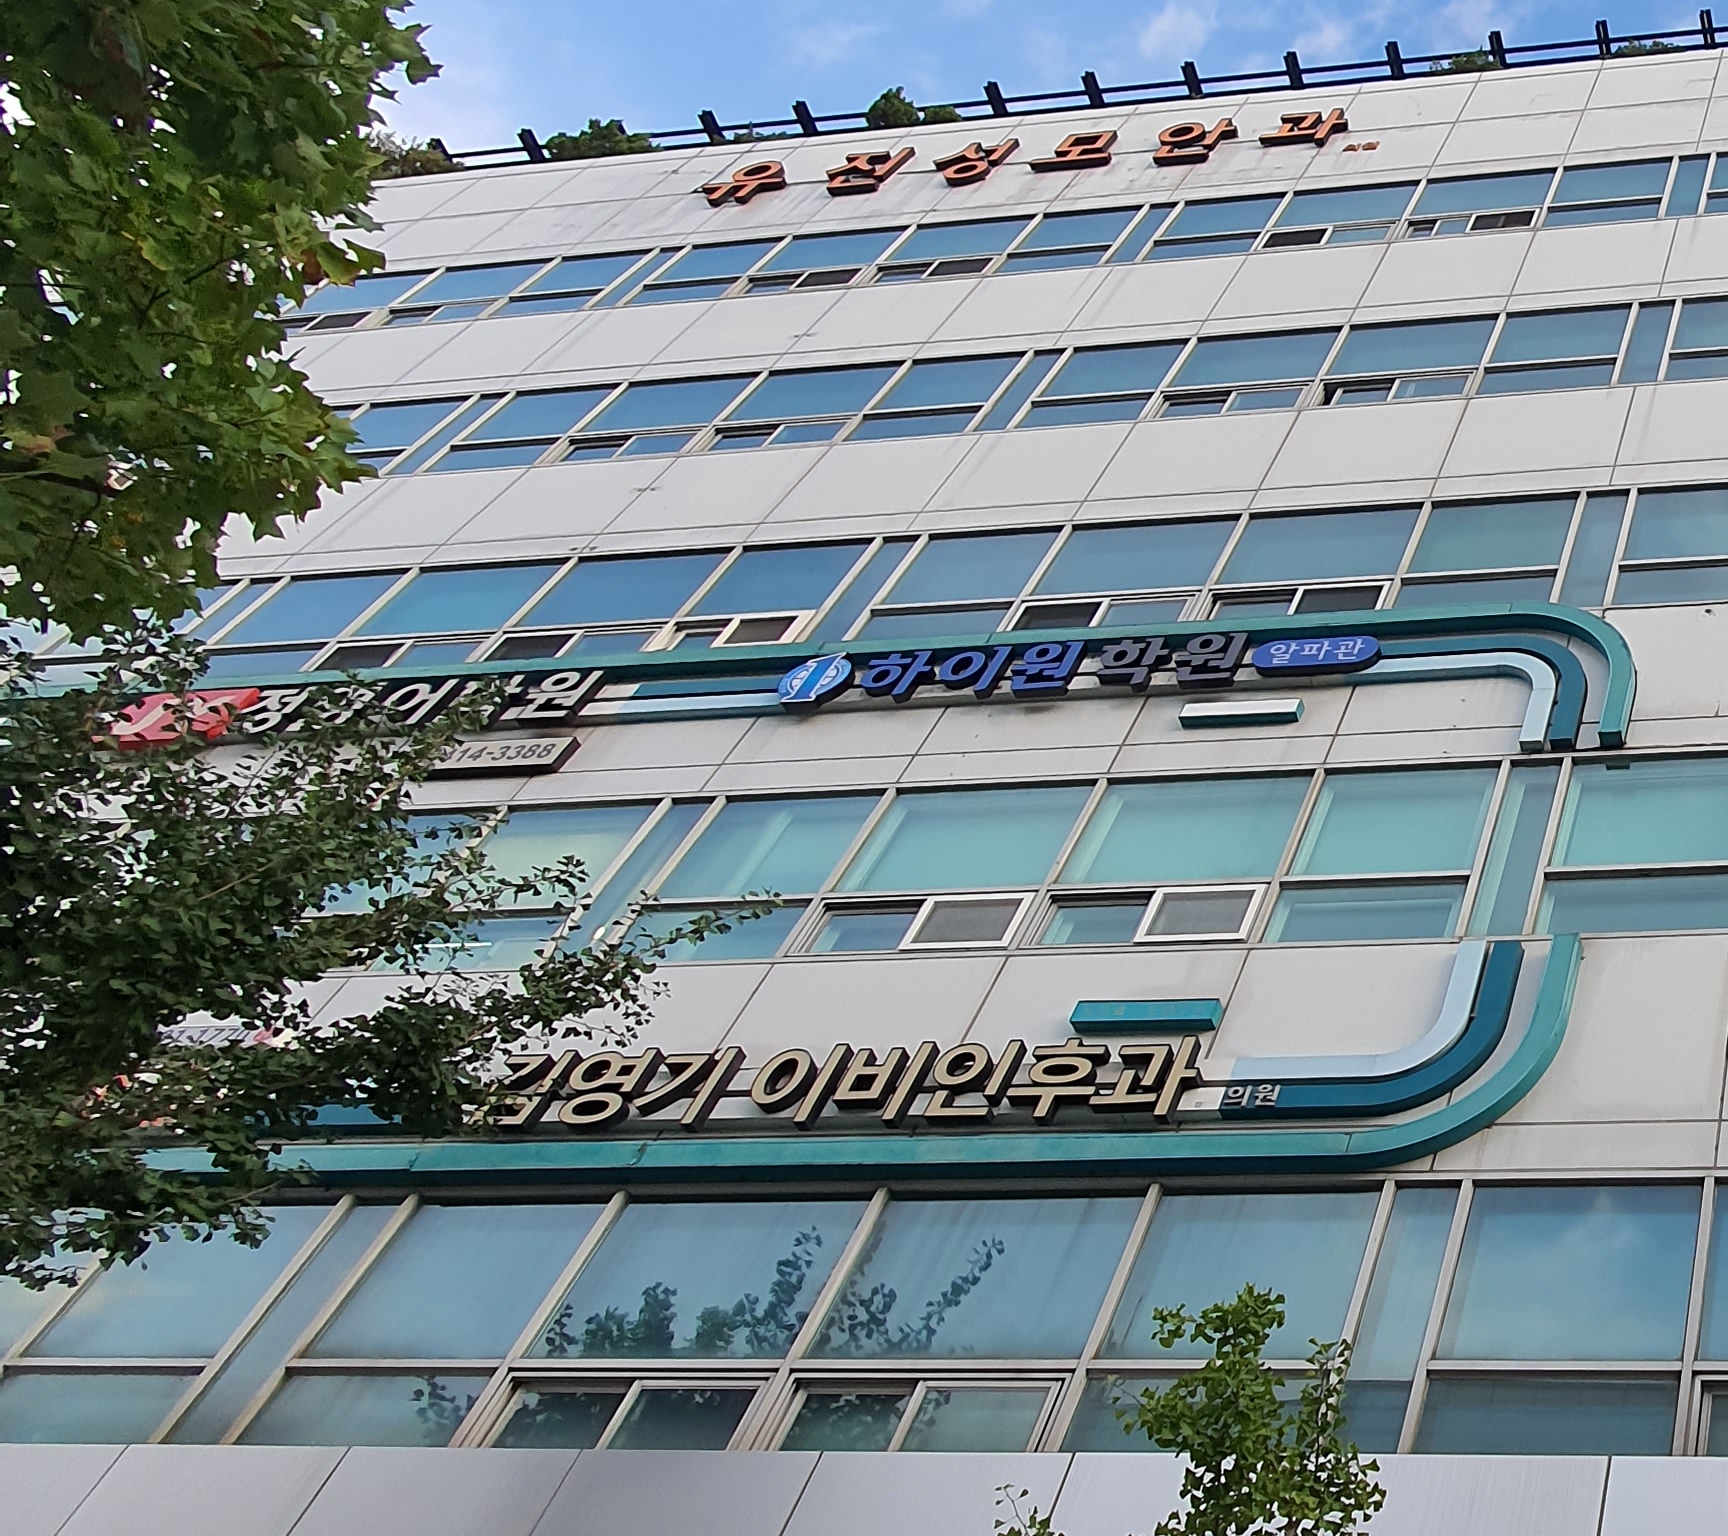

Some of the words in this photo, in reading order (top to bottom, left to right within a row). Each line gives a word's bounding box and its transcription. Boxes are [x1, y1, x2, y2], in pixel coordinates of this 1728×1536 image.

[702, 107, 1348, 206] 유진성모안과
[859, 641, 1086, 698] 하이원
[1097, 631, 1249, 686] 학원
[1269, 637, 1366, 664] 알파관
[751, 1035, 1199, 1123] 이비인후과
[1223, 1083, 1282, 1107] 의원
